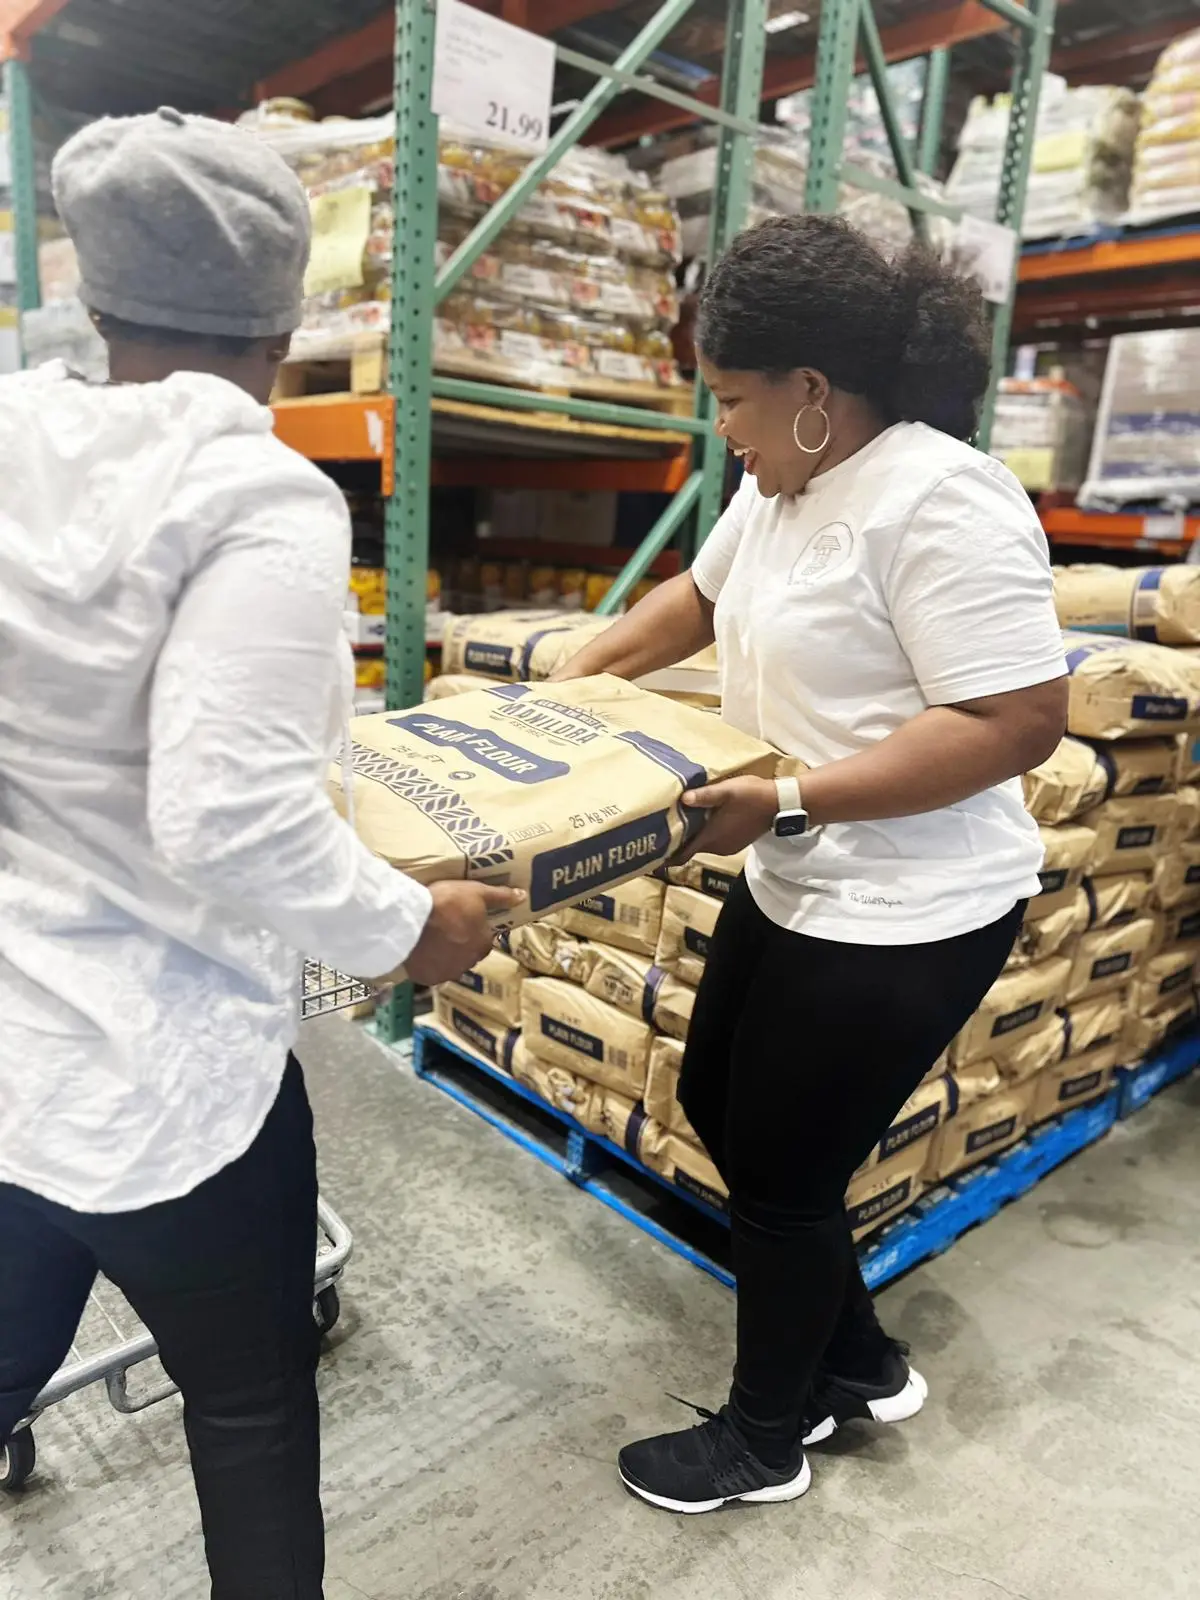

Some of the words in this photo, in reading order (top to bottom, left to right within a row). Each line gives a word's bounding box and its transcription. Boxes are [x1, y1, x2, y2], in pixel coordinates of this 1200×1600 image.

[485, 101, 543, 141] 21.99
[497, 702, 600, 744] MANILDRA
[411, 722, 478, 743] PLAIN
[465, 738, 539, 774] FLOUR
[568, 814, 586, 829] 25
[585, 811, 604, 825] kg
[599, 804, 623, 820] NET
[552, 852, 604, 890] PLAIN
[607, 833, 658, 869] FLOUR
